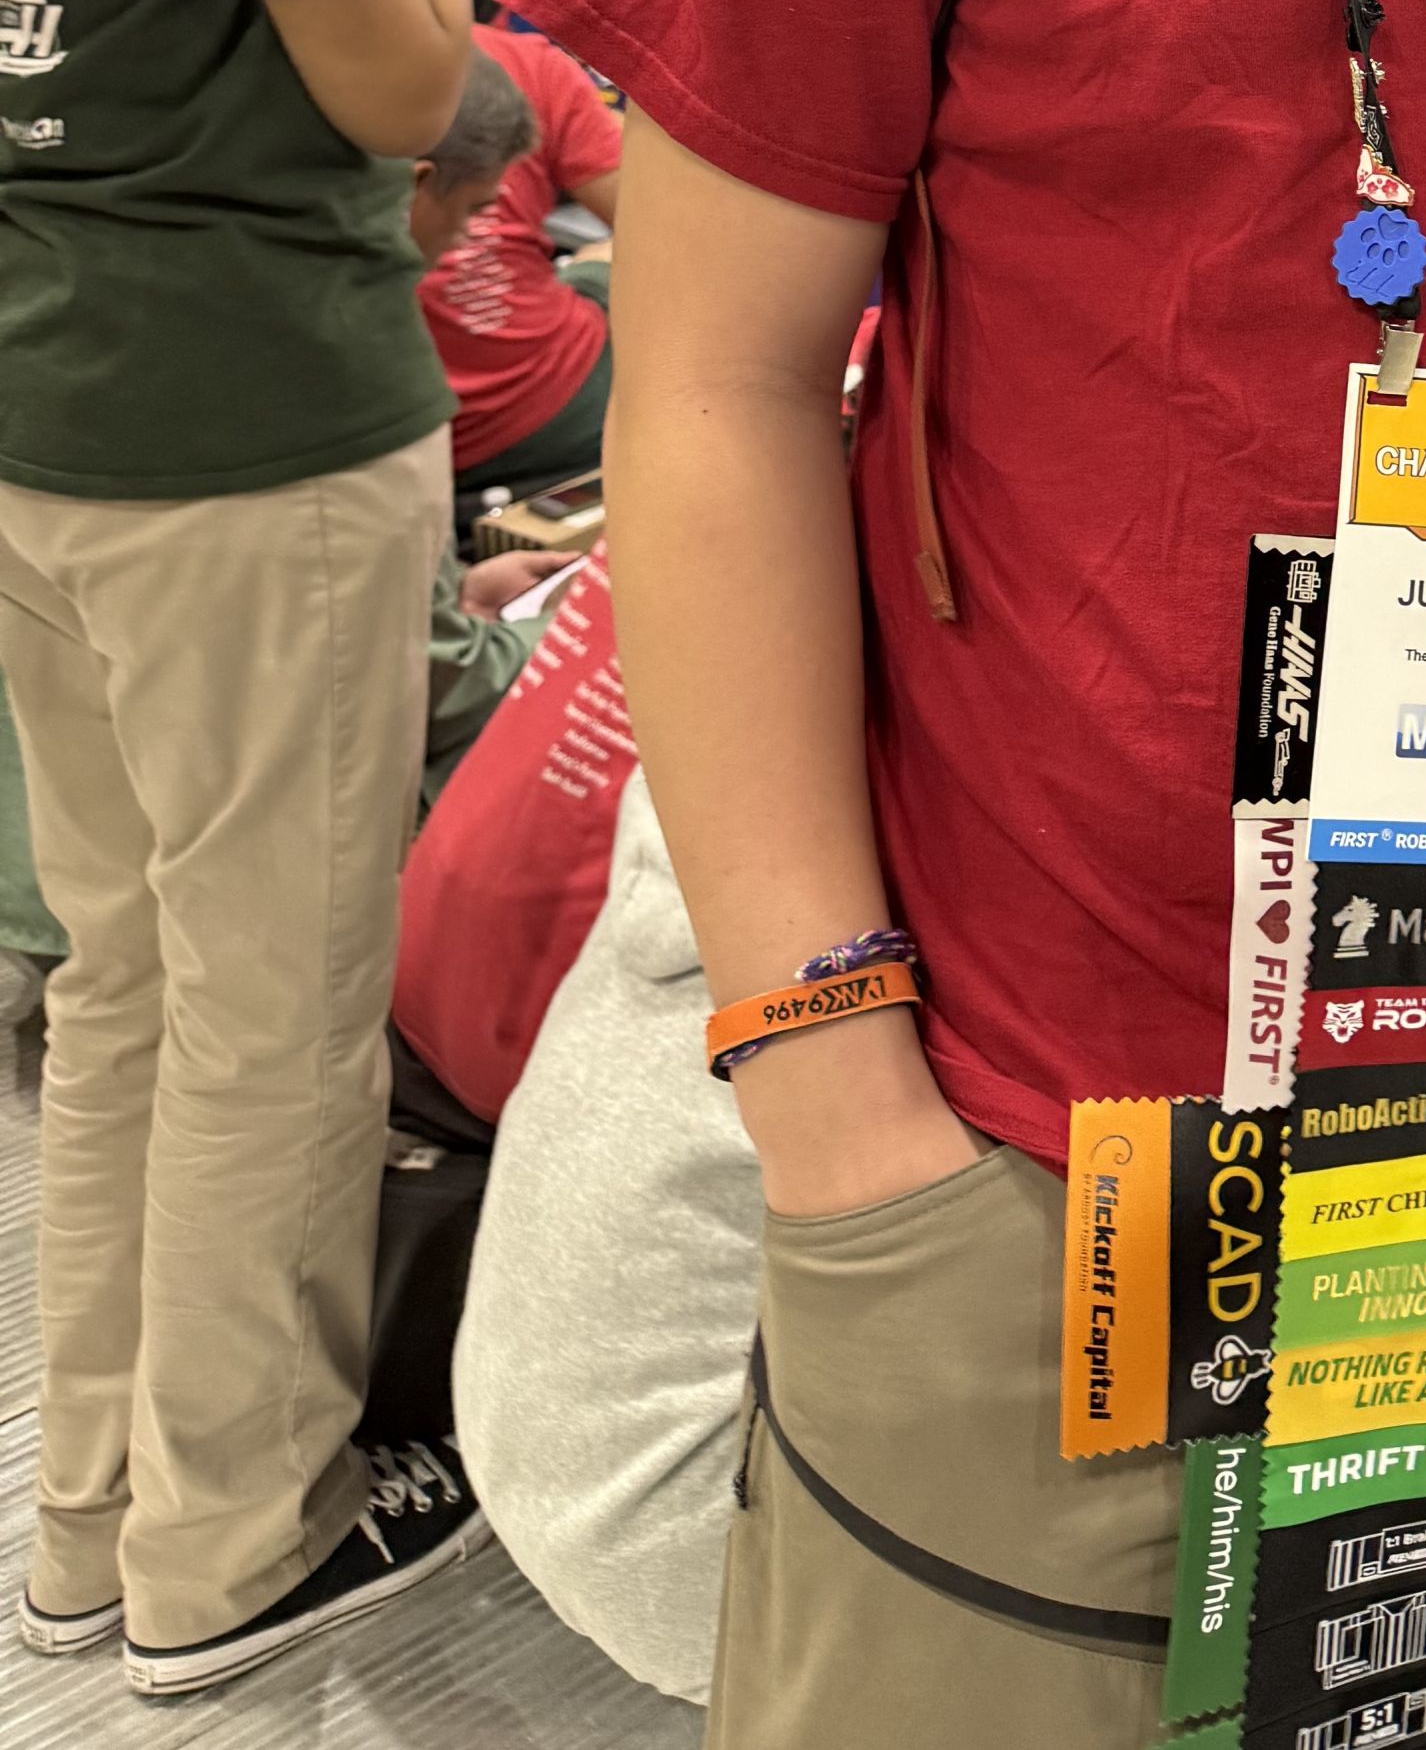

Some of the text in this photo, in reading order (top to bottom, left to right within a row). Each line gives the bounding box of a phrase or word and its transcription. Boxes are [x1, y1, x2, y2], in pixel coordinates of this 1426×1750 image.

[1258, 606, 1281, 738] Gene Haas Foundation
[1277, 604, 1316, 743] HAAS
[1260, 819, 1294, 890] WPI
[1375, 998, 1418, 1008] TEAM
[1207, 1121, 1263, 1322] SCAD
[1311, 1196, 1383, 1225] FIRST
[1083, 1173, 1119, 1420] Kickoff Capital
[1287, 1350, 1414, 1387] NOTHING
[1354, 1380, 1414, 1409] LIKE
[1201, 1448, 1246, 1634] he/him/his
[1359, 1702, 1395, 1732] 5:1
